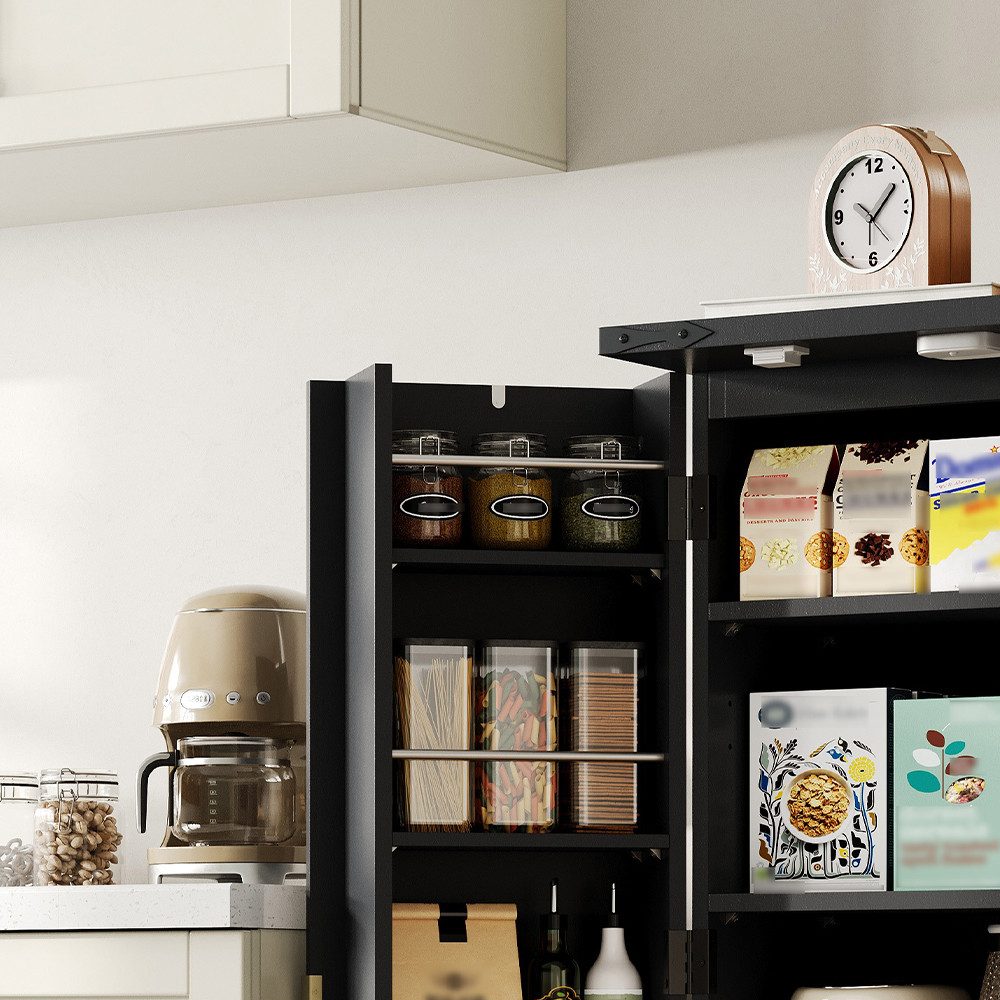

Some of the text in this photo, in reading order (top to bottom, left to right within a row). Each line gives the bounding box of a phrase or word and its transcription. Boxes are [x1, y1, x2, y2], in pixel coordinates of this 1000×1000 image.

[865, 157, 884, 174] 12
[834, 209, 844, 225] 9
[868, 251, 878, 267] 6
